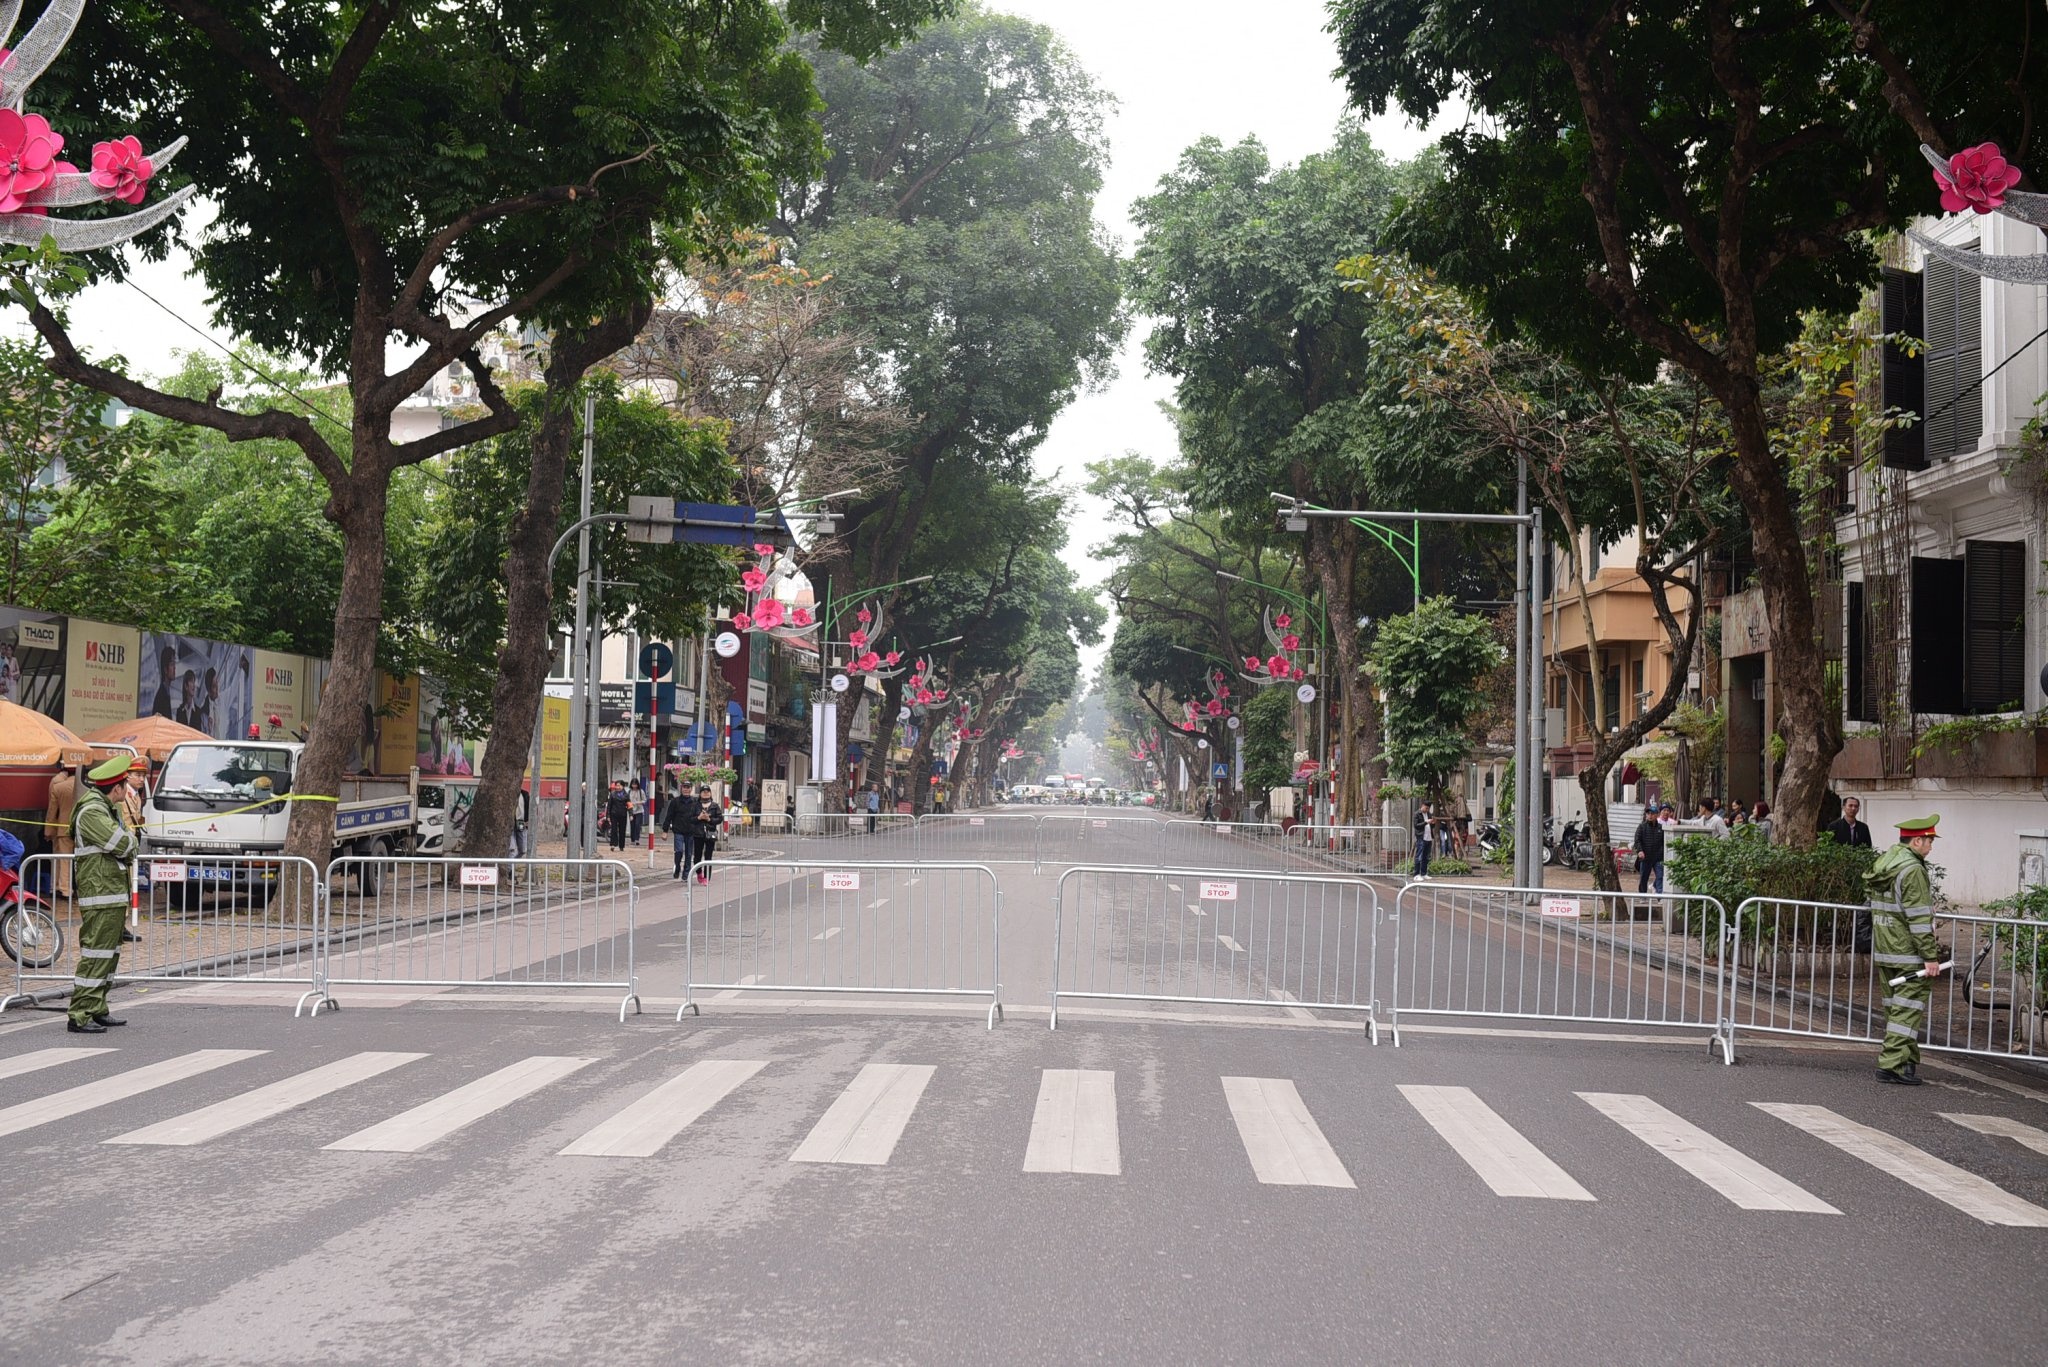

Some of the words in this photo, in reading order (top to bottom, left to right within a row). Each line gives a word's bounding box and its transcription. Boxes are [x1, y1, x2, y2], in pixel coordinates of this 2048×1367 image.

[25, 626, 54, 640] THACO
[99, 643, 125, 665] SHB
[274, 669, 293, 687] SHB
[601, 690, 625, 698] HOTEL
[69, 752, 86, 762] CSGT
[360, 812, 371, 824] SÁT
[183, 841, 241, 849] MITSUBISHI
